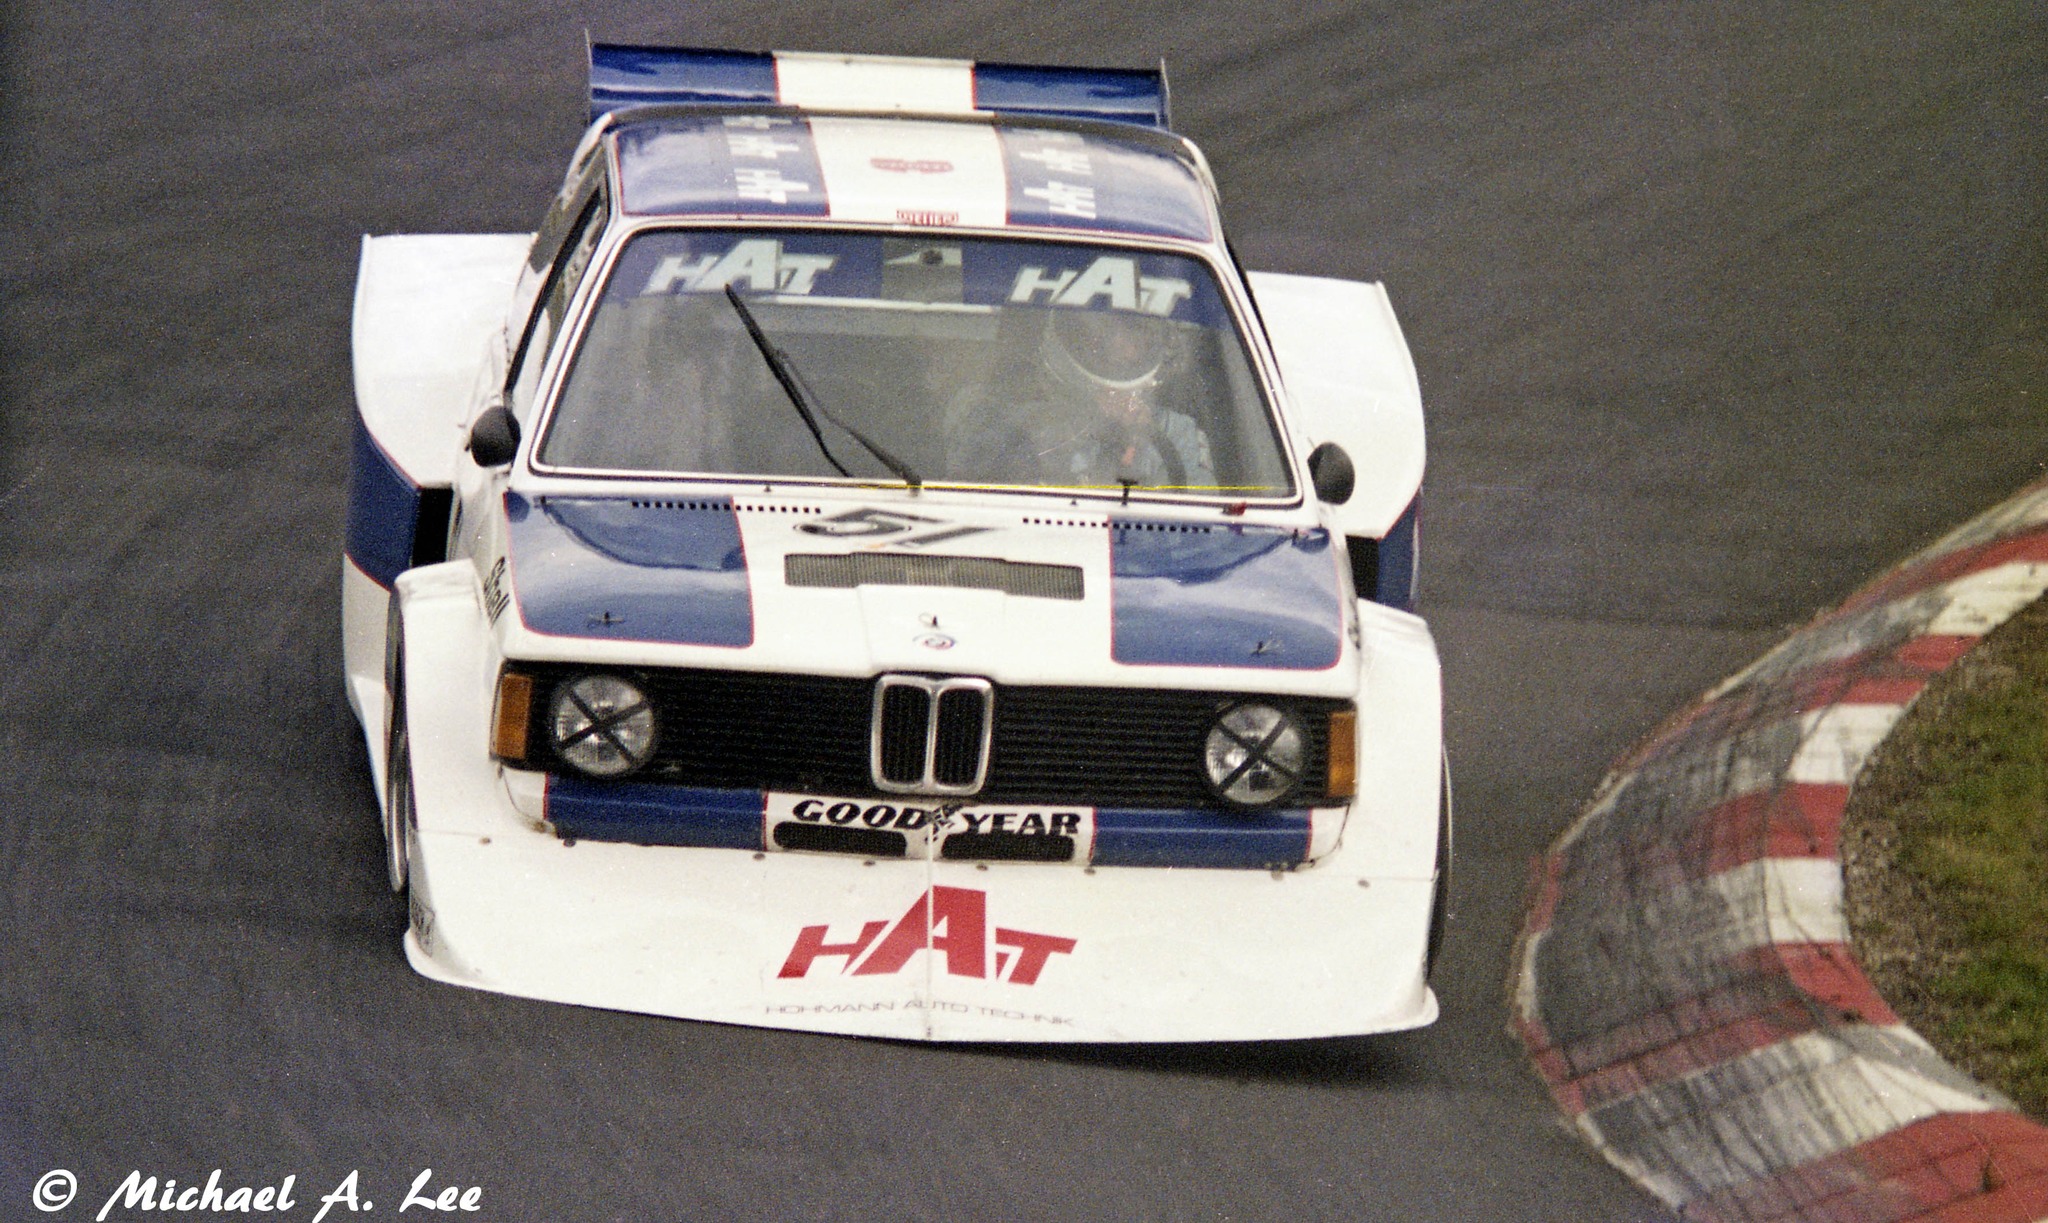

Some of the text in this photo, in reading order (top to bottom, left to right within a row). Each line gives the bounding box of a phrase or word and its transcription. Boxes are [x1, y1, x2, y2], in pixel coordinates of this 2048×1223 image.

[643, 239, 837, 295] HAT
[1010, 256, 1192, 317] HAT
[776, 884, 1078, 987] HAT
[765, 999, 1076, 1027] HOHMANN AUTO TECHNIK
